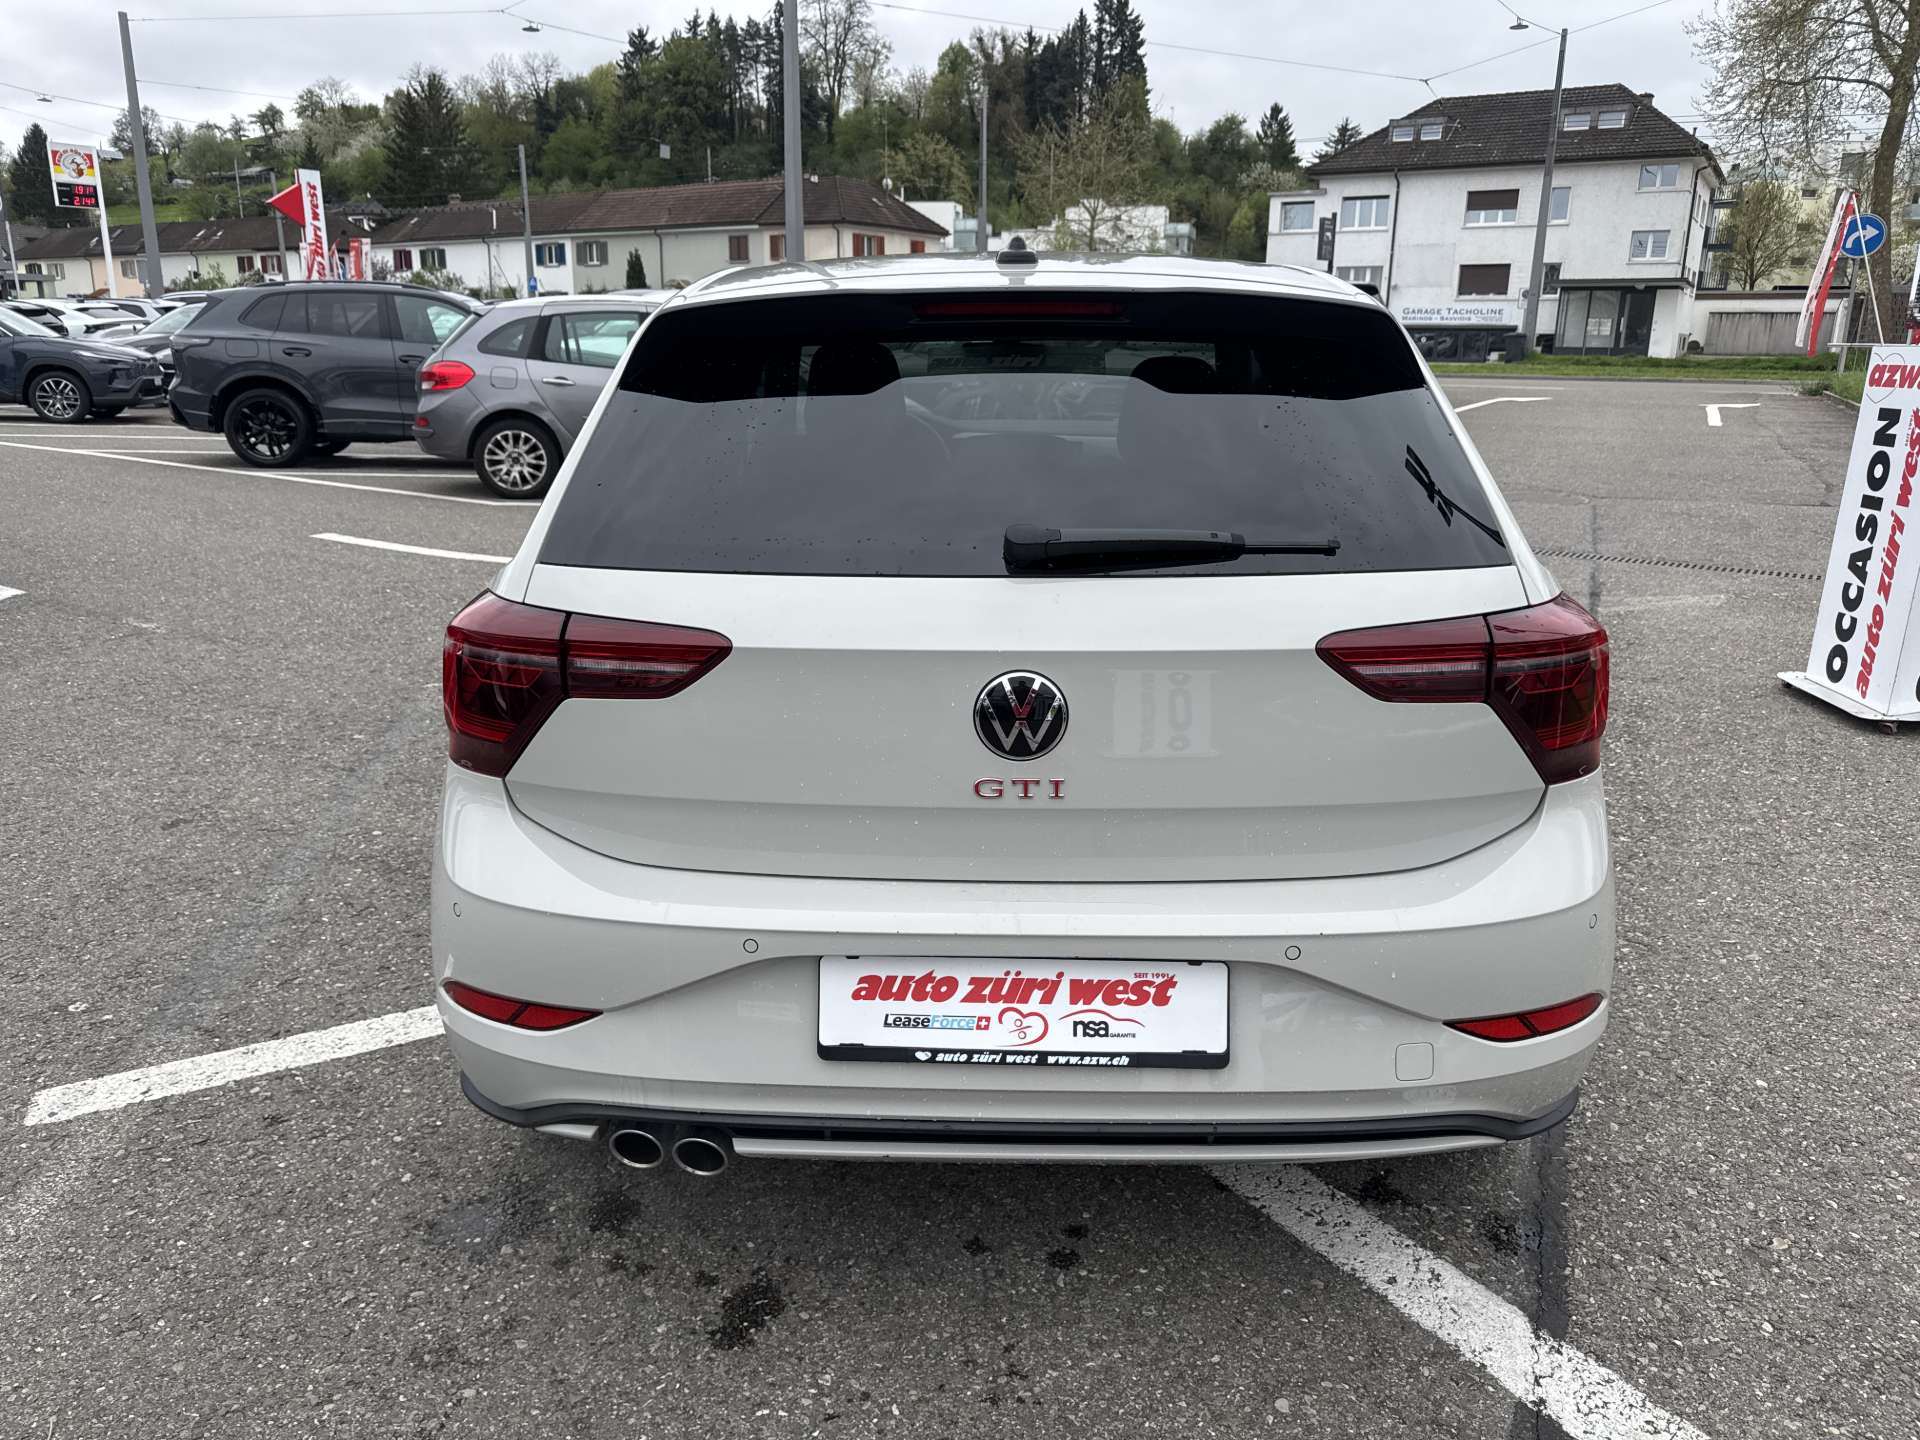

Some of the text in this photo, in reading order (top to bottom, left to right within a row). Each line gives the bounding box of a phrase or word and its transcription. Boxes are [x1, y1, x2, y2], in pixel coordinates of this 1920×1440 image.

[306, 181, 320, 222] west
[1402, 307, 1504, 315] GARAGE TACHOLINE
[1825, 406, 1902, 684] OCCASION
[1856, 604, 1885, 700] auto
[1876, 509, 1906, 608] züri
[974, 778, 1065, 799] GTI
[851, 969, 1178, 1008] auto züri west
[883, 1012, 976, 1030] LeaseForce
[1072, 1020, 1110, 1038] nsa
[935, 1051, 1130, 1067] auto züri west www.azw.ch
